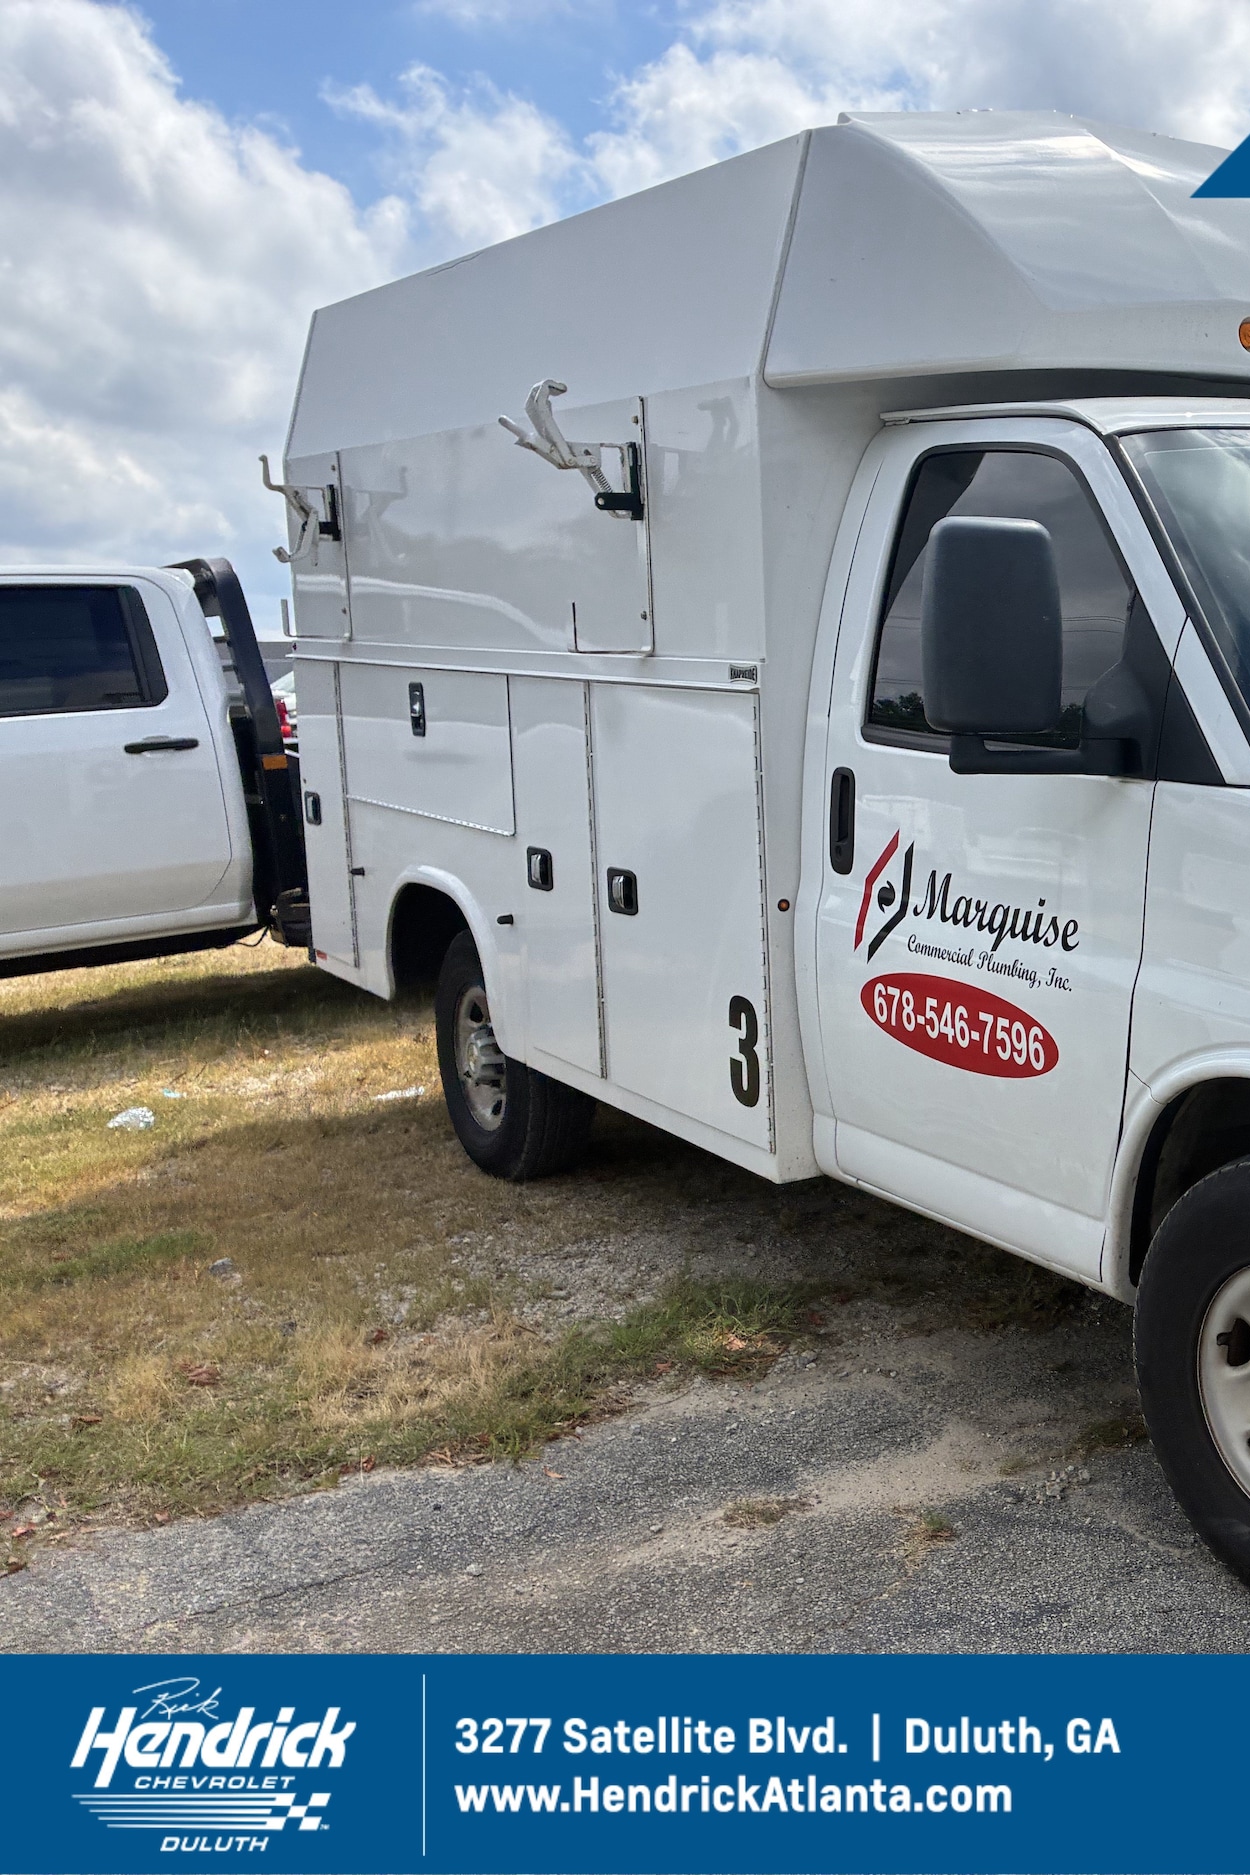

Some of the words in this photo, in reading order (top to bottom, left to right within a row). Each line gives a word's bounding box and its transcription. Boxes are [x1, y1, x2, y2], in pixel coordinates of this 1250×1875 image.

[913, 869, 1080, 952] Marquise
[907, 934, 974, 968] Commercial
[976, 951, 1042, 989] Plumbing,
[1047, 966, 1073, 992] Inc.
[729, 995, 760, 1108] 3
[873, 982, 1046, 1071] 678-546-7596
